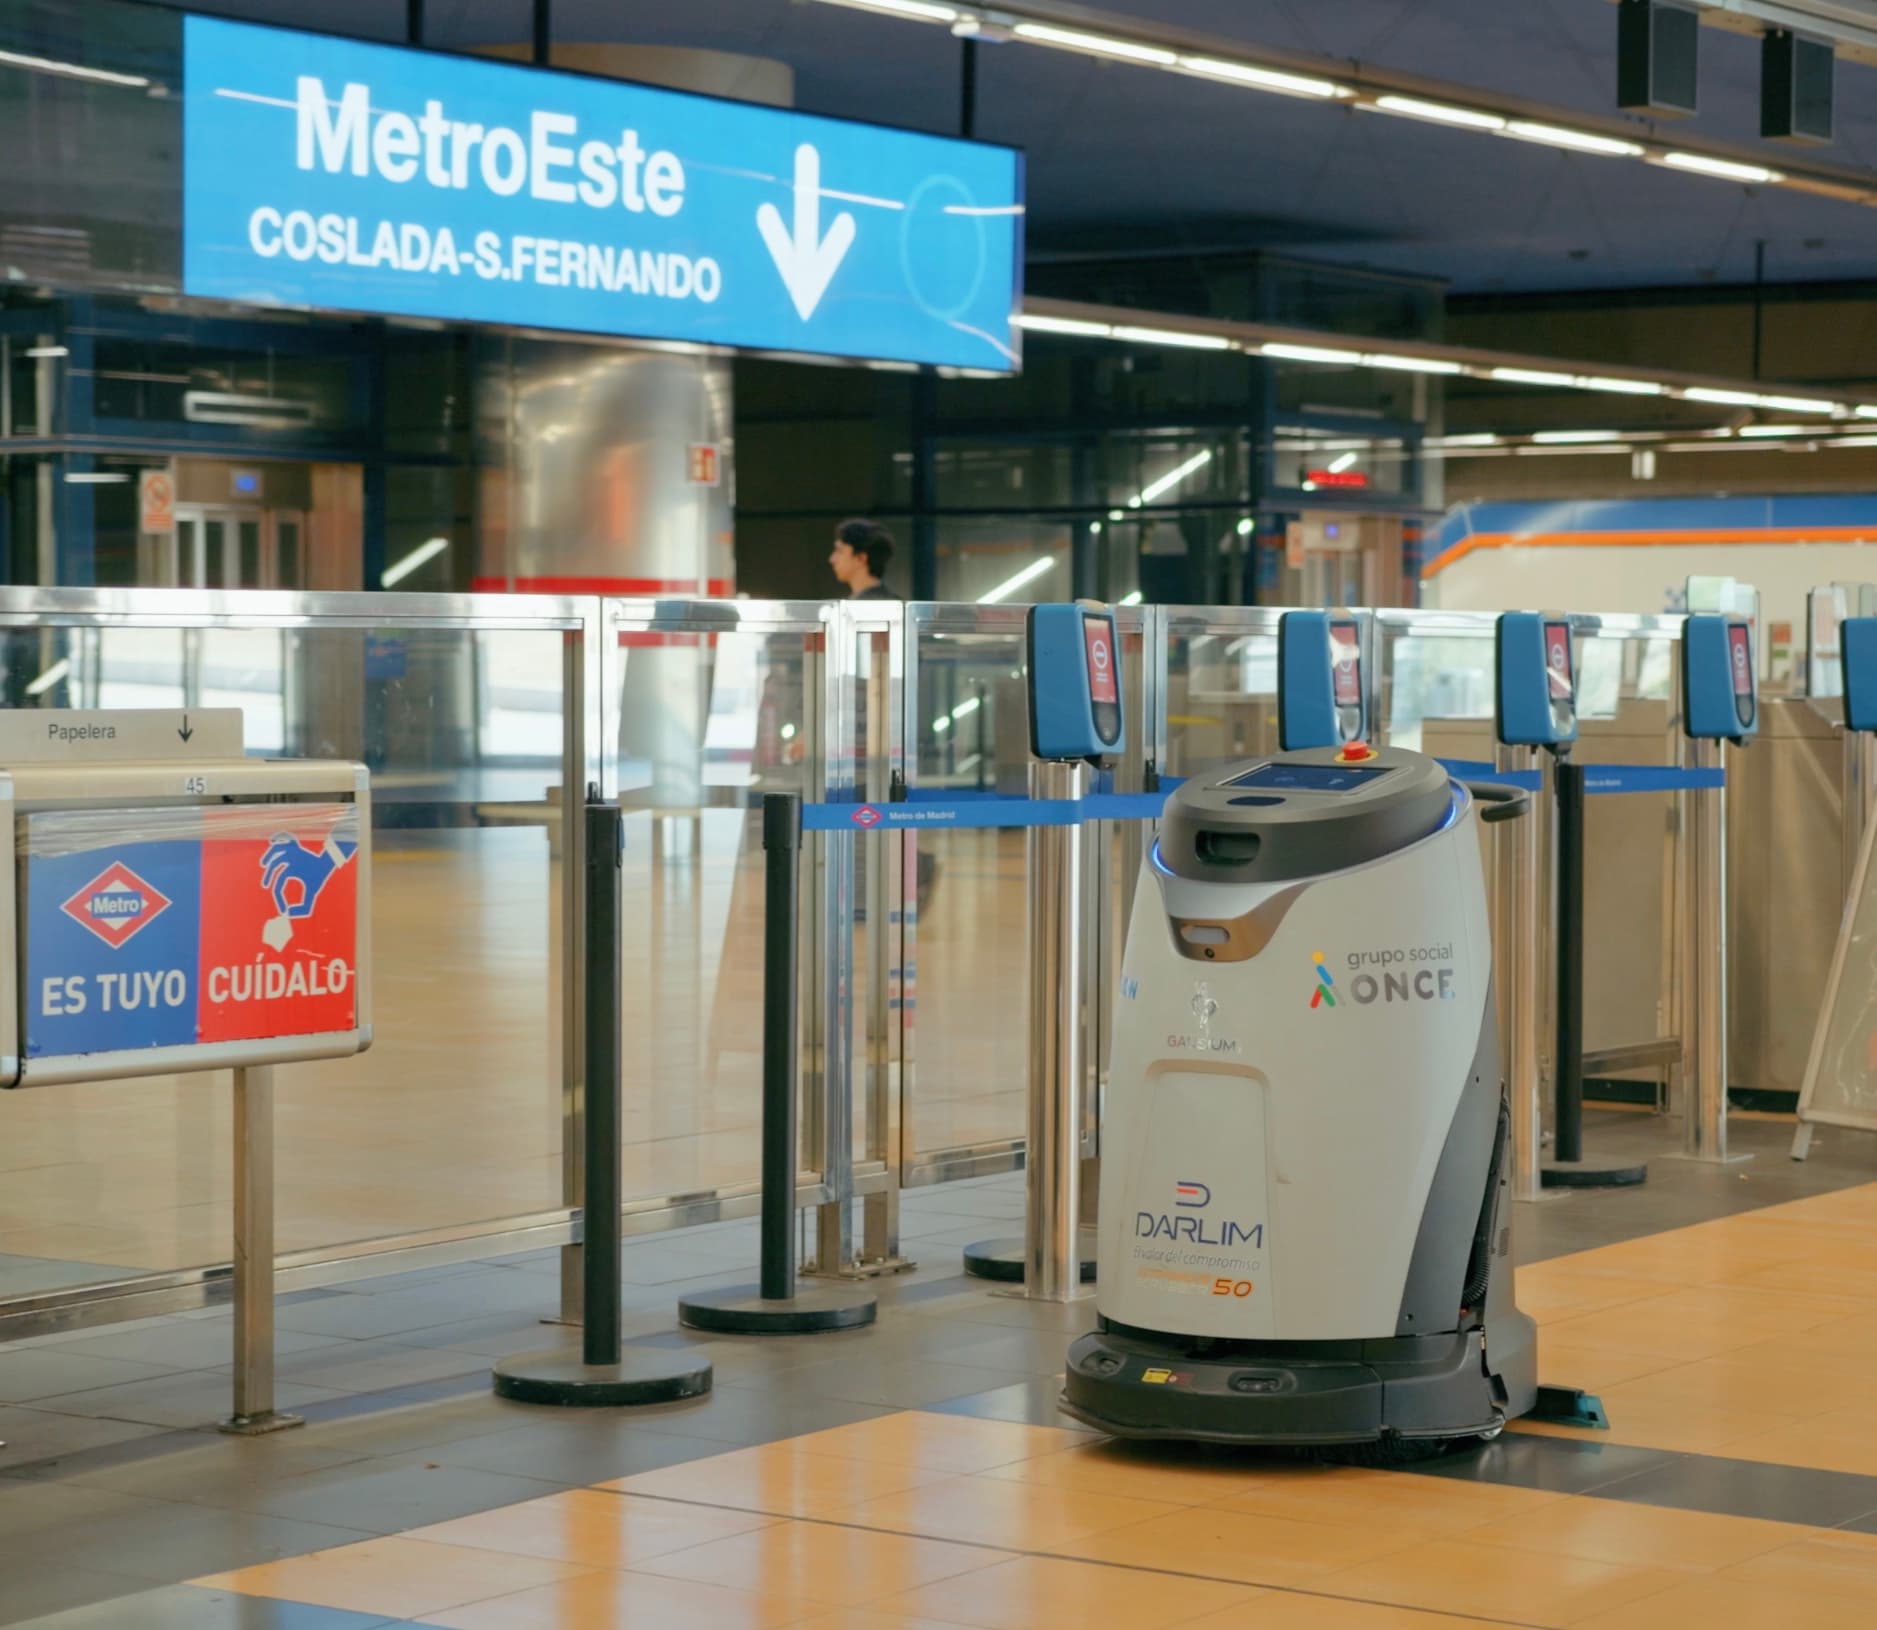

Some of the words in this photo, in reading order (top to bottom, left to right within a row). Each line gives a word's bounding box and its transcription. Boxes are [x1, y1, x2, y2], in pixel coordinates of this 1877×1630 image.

[296, 75, 686, 217] MetroEste
[248, 206, 722, 304] COSLADA-S.FERNANDO
[48, 723, 116, 744] Papelera
[185, 777, 205, 794] 45
[92, 896, 140, 915] Metro
[1347, 949, 1405, 970] grupo
[1409, 942, 1453, 961] social
[41, 975, 87, 1016] ES
[96, 968, 187, 1012] TUYO
[207, 952, 349, 1004] CUÍDALO
[1136, 1211, 1263, 1249] DARLIM
[1212, 1278, 1253, 1298] 50
